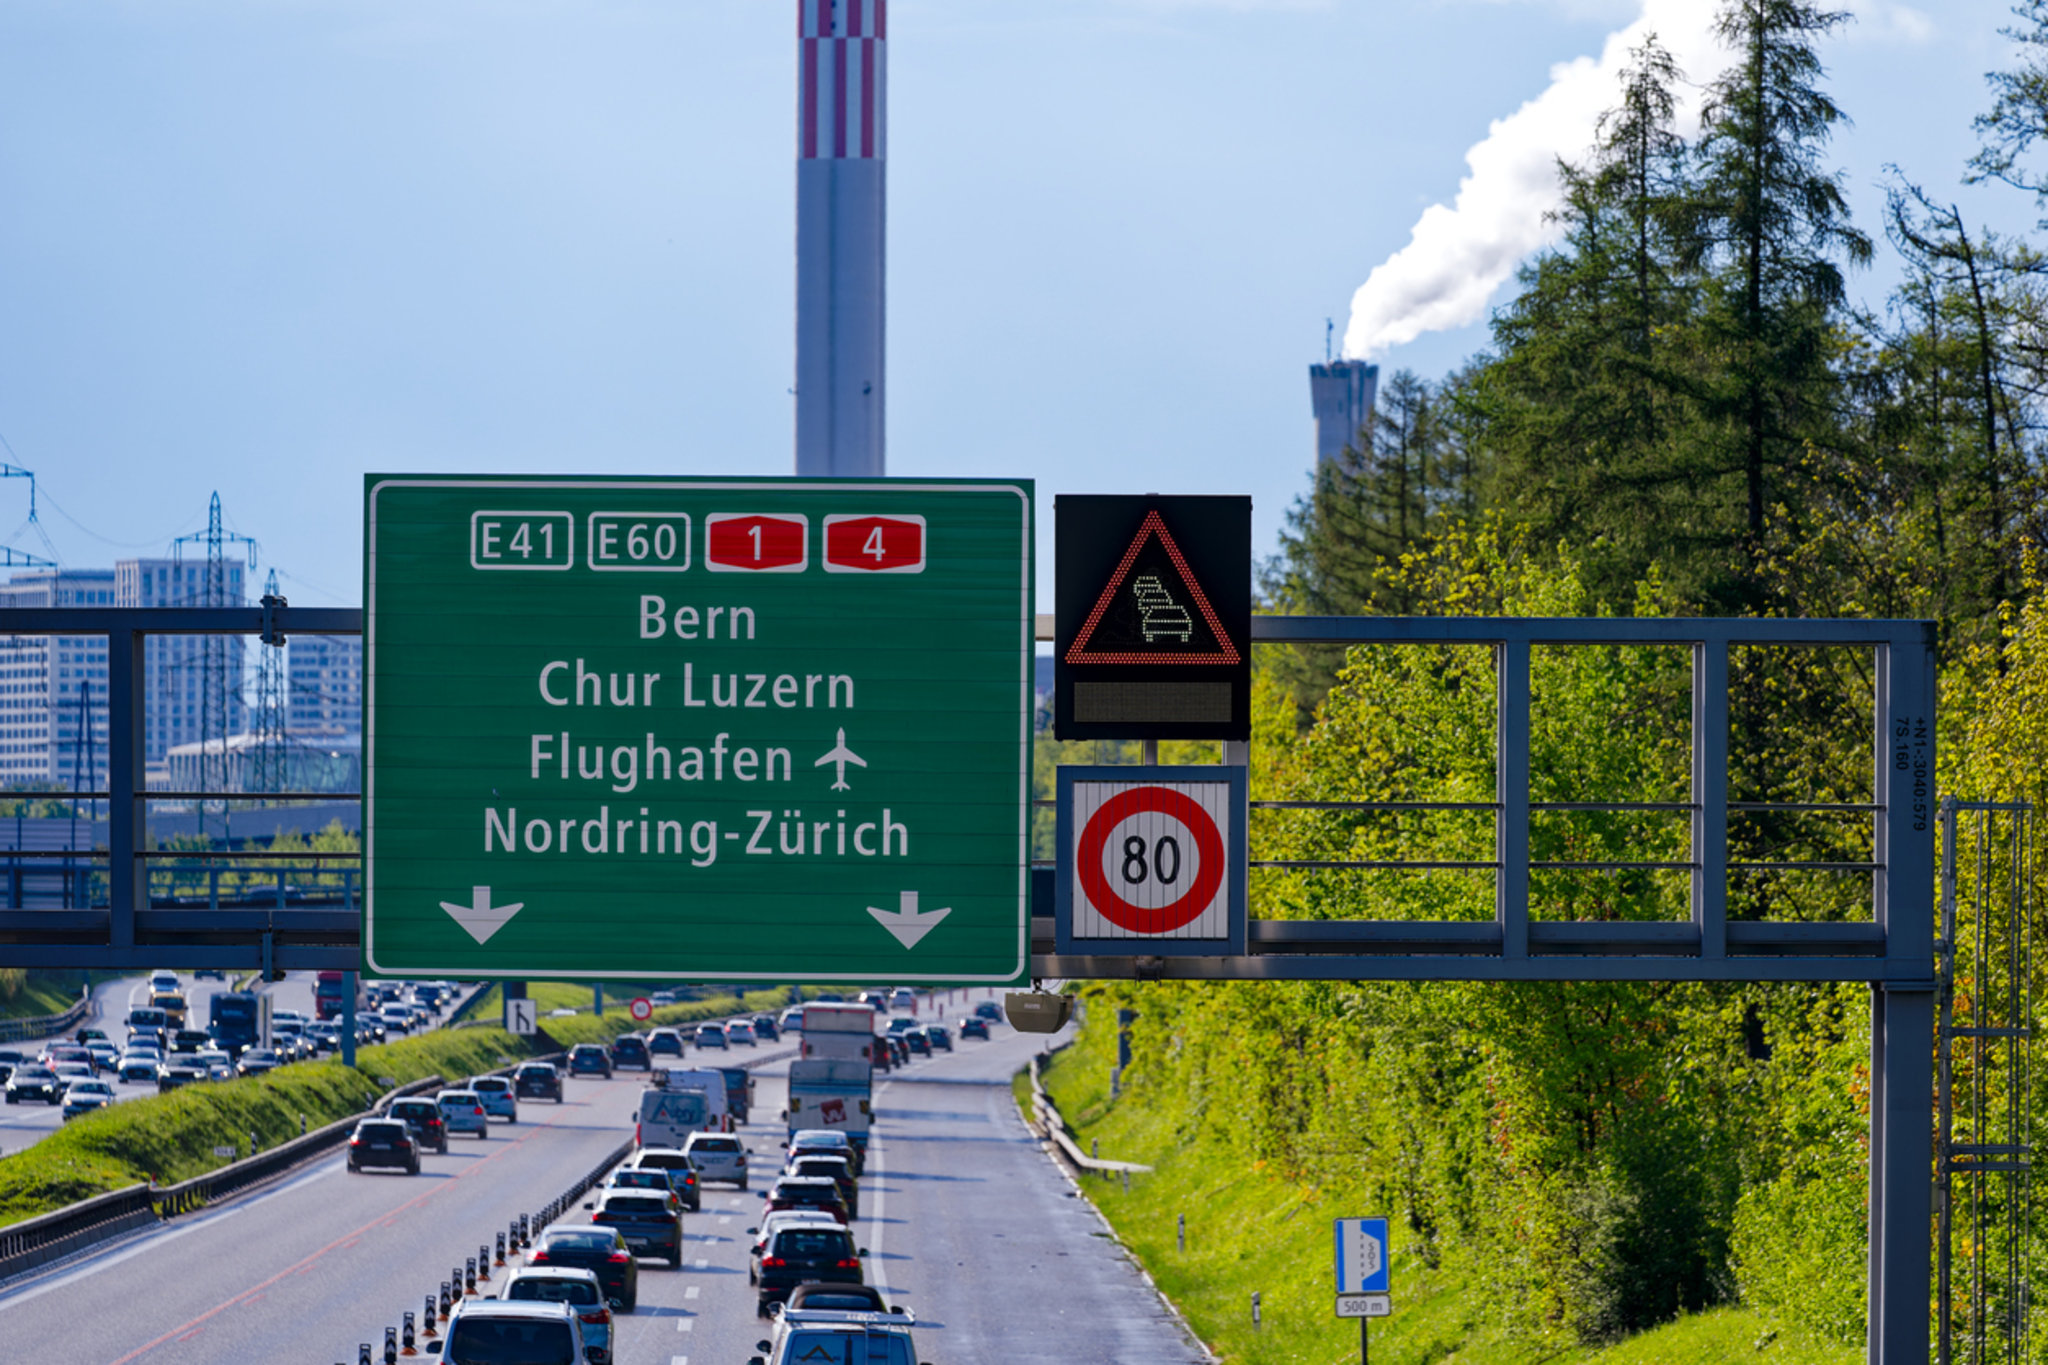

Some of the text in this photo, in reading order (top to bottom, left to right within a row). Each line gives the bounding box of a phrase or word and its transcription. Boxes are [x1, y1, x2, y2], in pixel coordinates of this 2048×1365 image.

[748, 525, 761, 561] 1
[862, 526, 886, 561] 4
[640, 595, 755, 640] Bern
[539, 658, 854, 708] Chur Luzern
[531, 732, 792, 793] Flughafen
[1896, 718, 1909, 770] 7S.160
[484, 805, 909, 868] Nordring-Zürich
[1122, 836, 1180, 884] 80
[1368, 1242, 1376, 1269] SOS
[1344, 1301, 1382, 1312] 500 m
